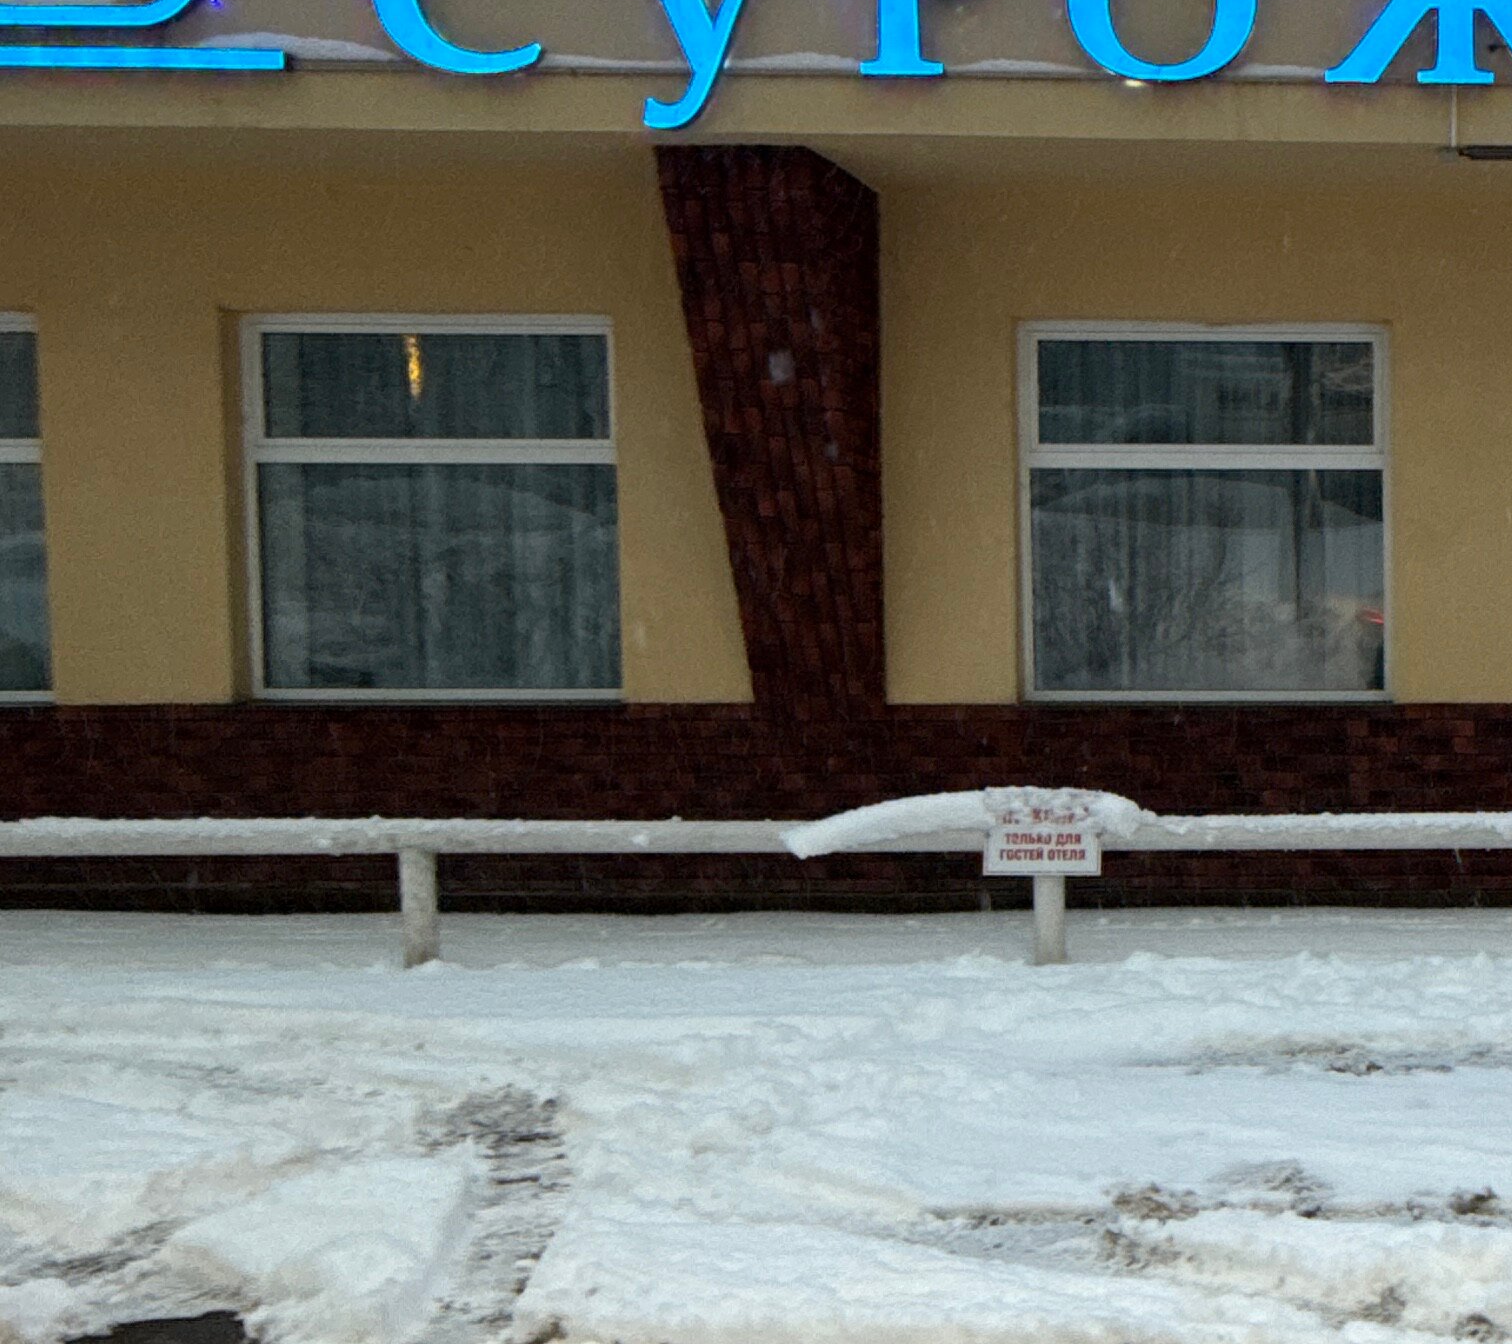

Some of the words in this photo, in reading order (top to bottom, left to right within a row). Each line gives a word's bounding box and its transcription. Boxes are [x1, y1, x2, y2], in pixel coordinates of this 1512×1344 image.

[1004, 832, 1052, 845] ТОЛЬКО
[1055, 832, 1082, 847] ДЛЯ
[1000, 847, 1043, 861] ГОСТЕЙ
[1047, 849, 1086, 861] ОТЕЛЯ
